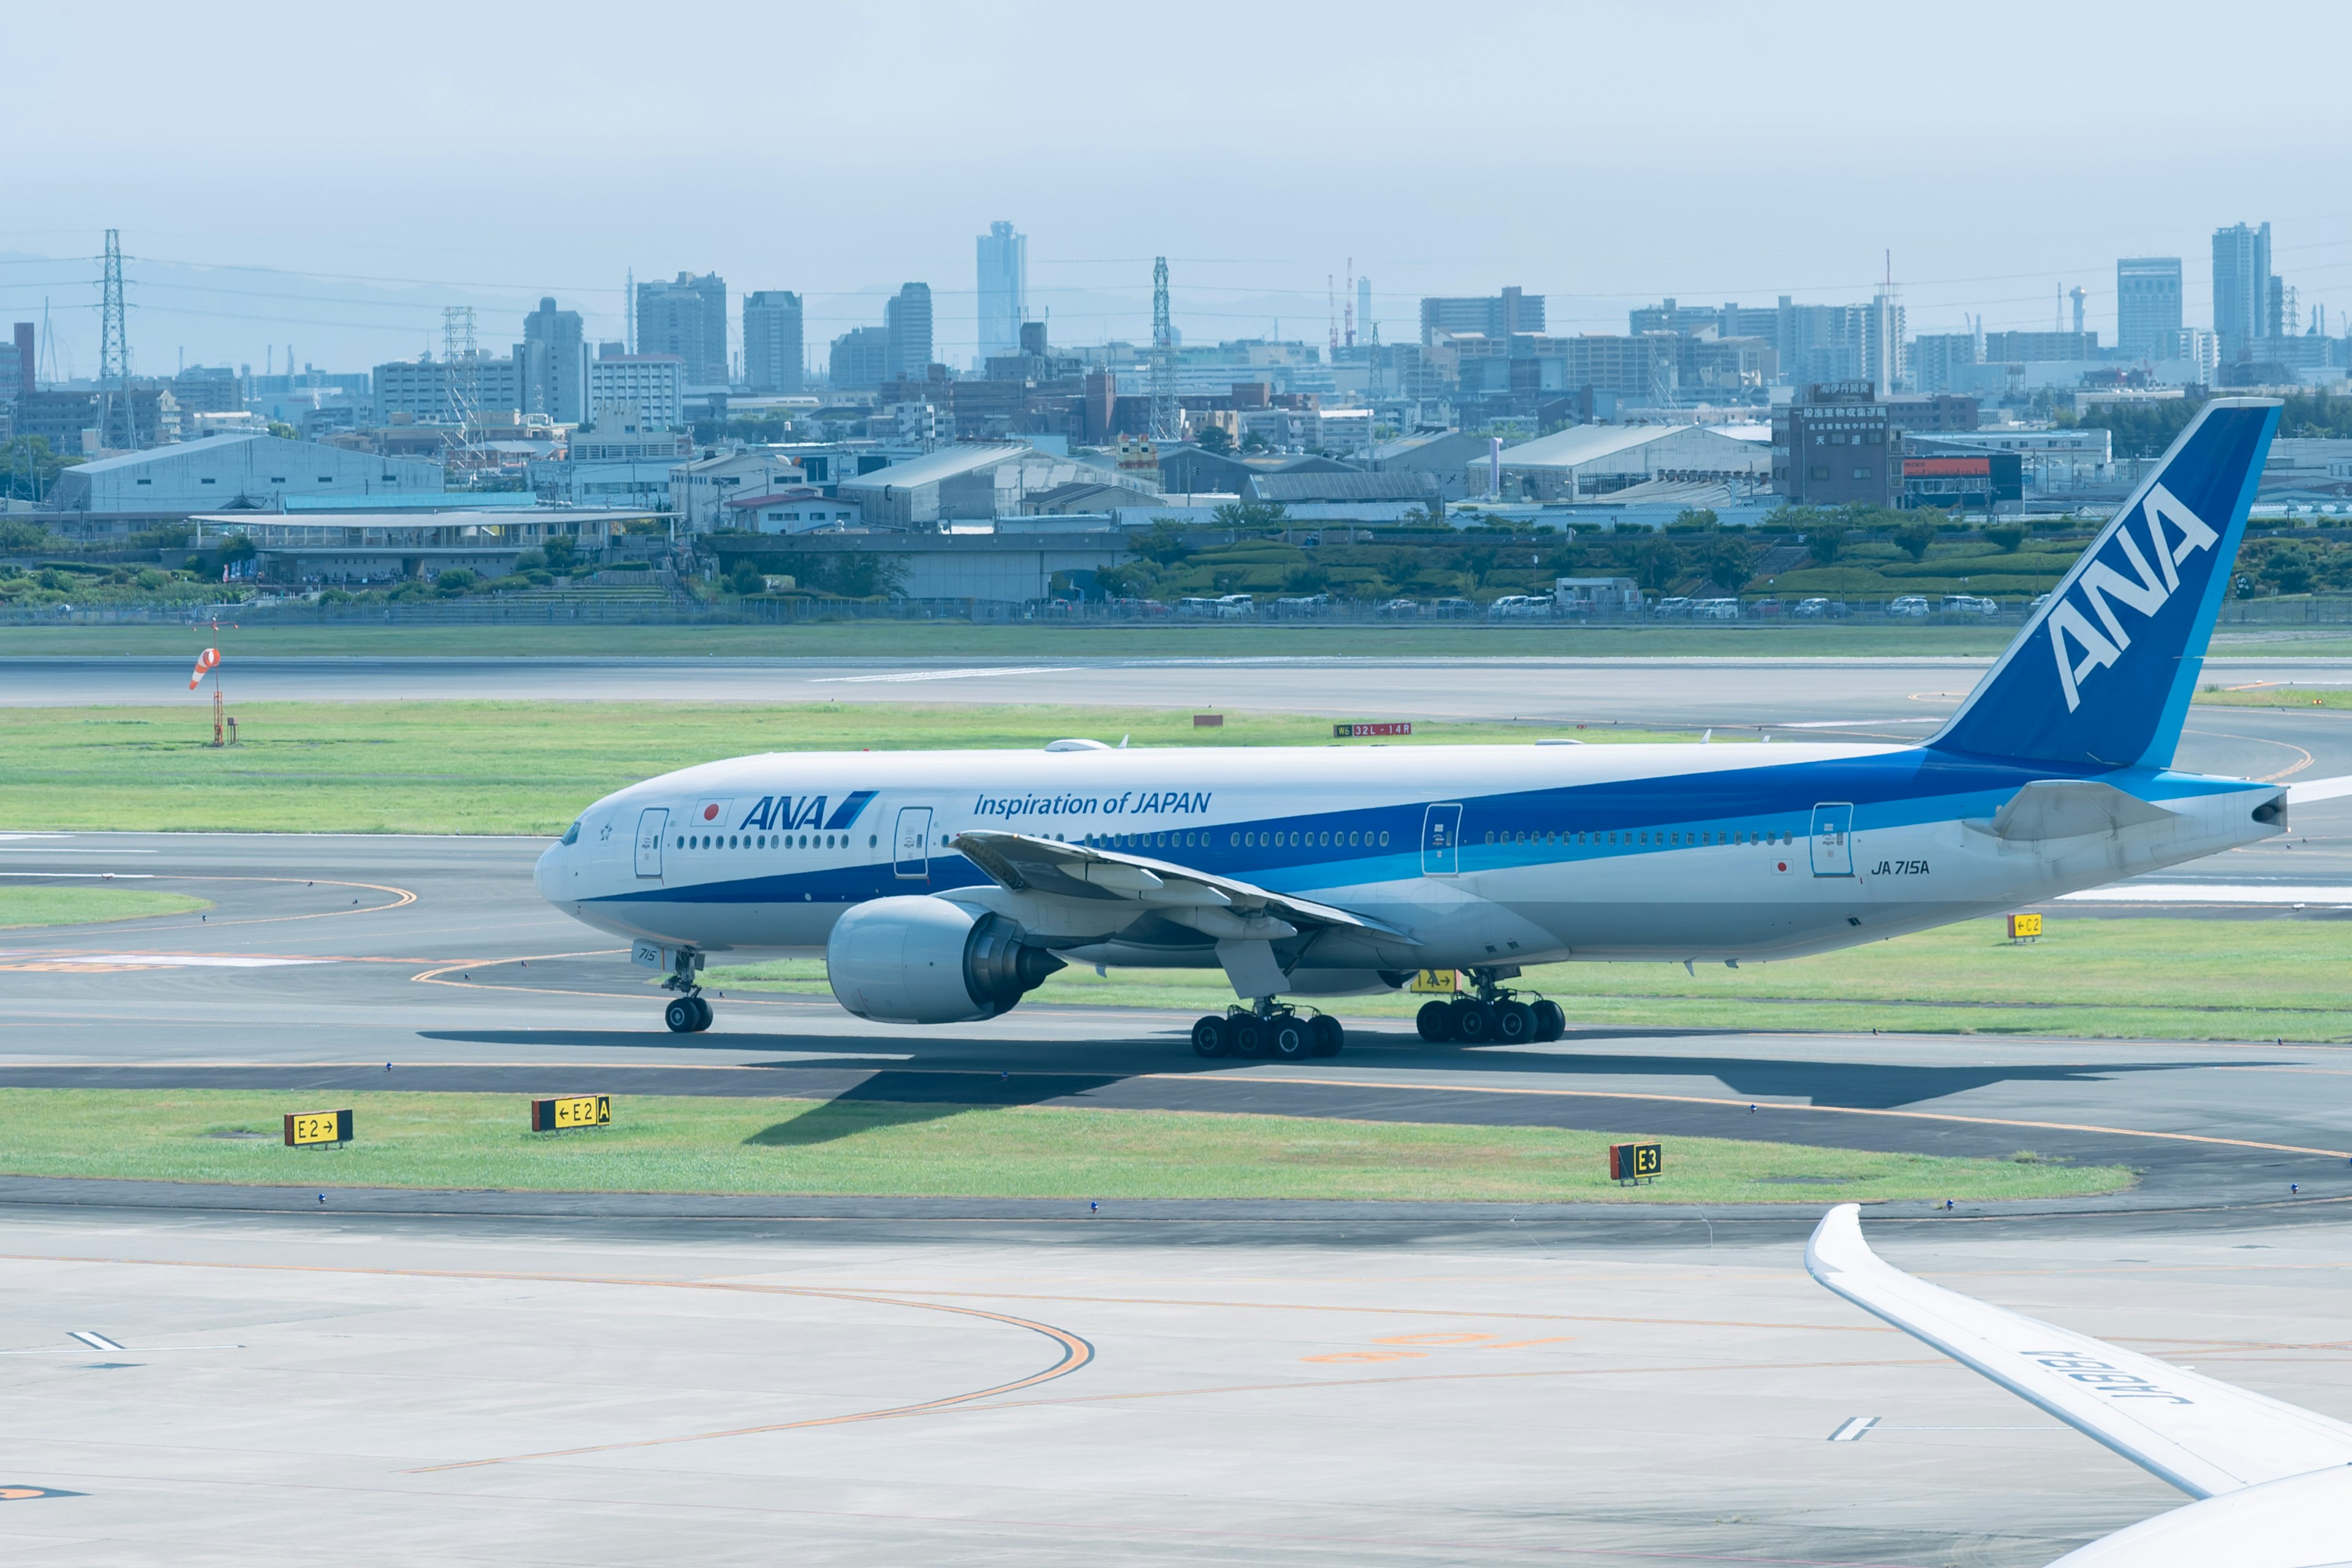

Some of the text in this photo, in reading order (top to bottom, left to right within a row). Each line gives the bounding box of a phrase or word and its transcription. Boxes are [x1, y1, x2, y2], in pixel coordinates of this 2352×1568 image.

[2048, 482, 2219, 714] ANA
[739, 796, 827, 830] ANA
[974, 792, 1212, 820] Inspiration of JAPAN
[2027, 918, 2038, 931] C2
[639, 948, 657, 961] 715
[574, 1100, 609, 1121] E2 A
[299, 1120, 318, 1138] E2
[1639, 1149, 1657, 1170] E3
